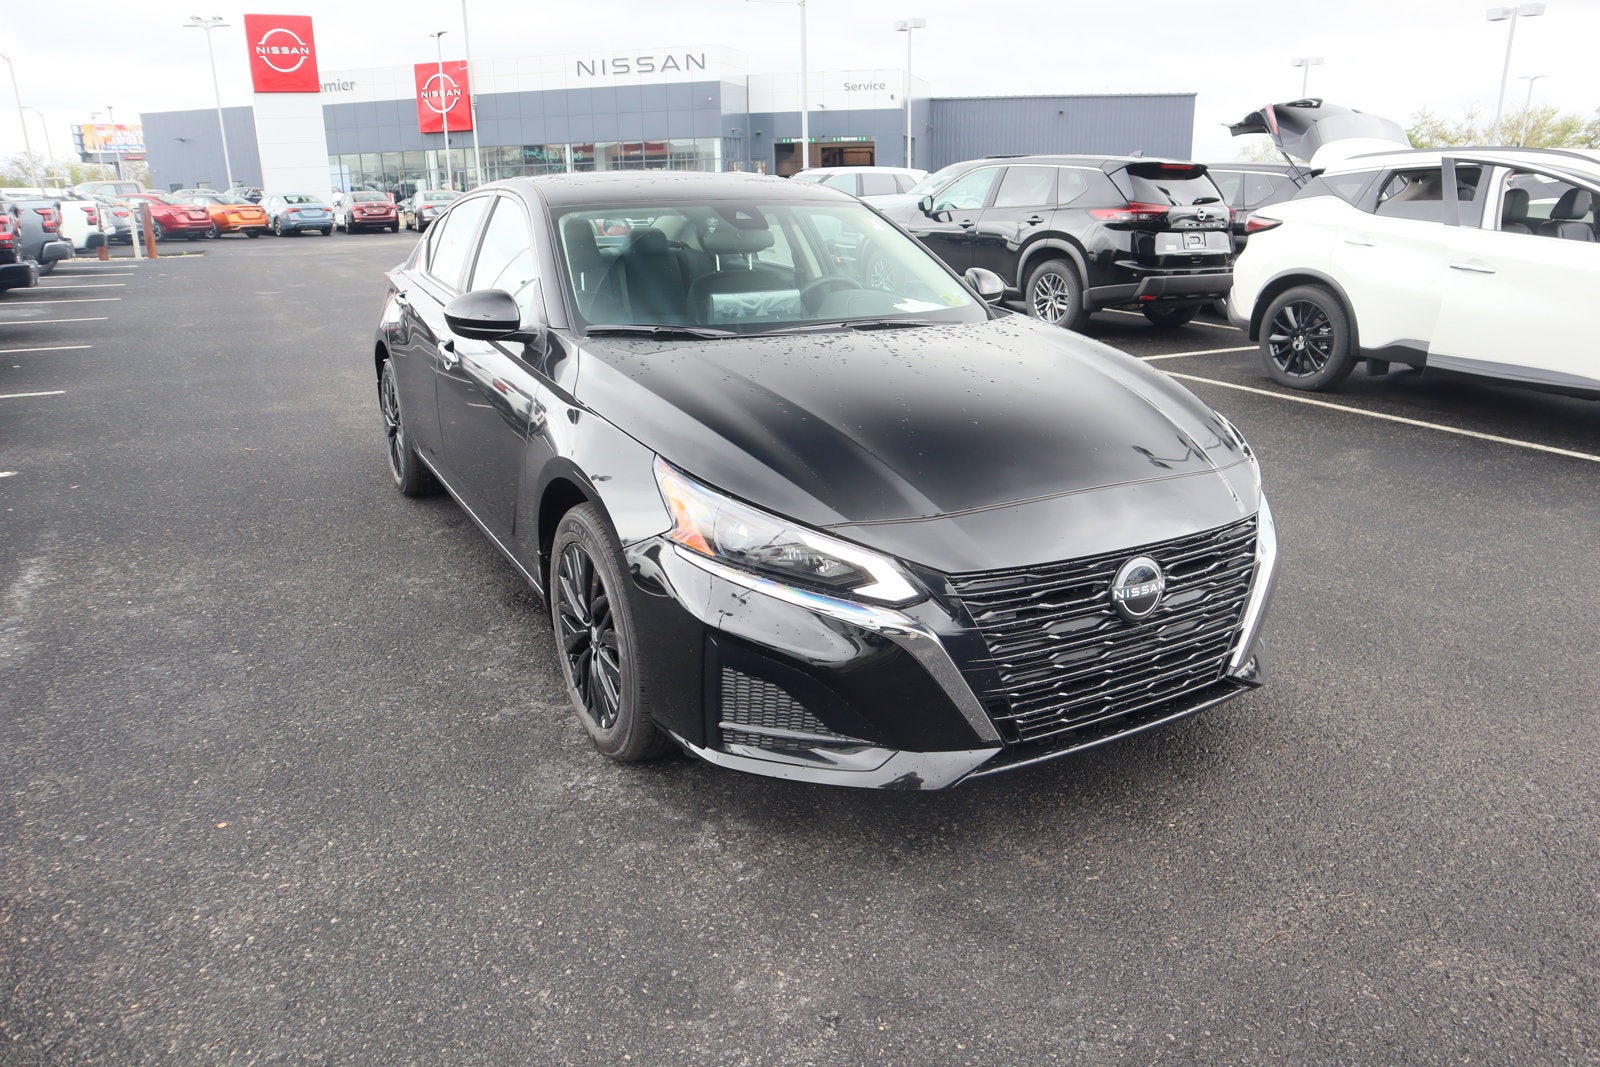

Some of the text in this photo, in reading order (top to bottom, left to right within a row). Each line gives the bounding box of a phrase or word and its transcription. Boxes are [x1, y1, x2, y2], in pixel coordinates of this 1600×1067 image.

[255, 46, 310, 55] NISSAN
[577, 53, 705, 77] NISSAN
[844, 81, 886, 91] Service
[1114, 578, 1166, 600] NISSAN
